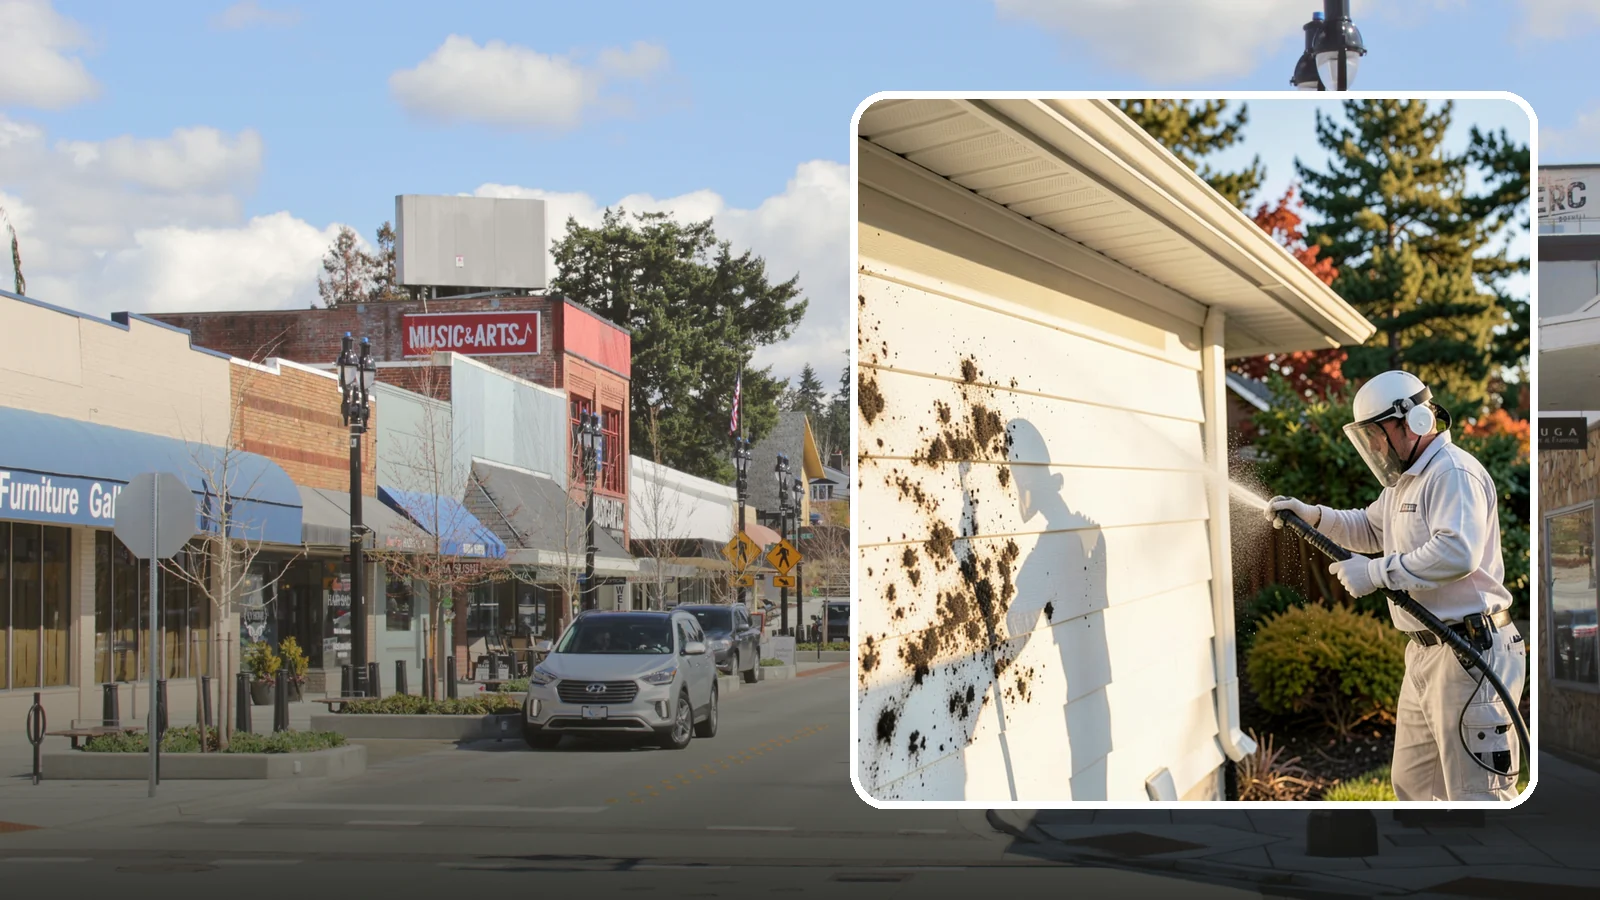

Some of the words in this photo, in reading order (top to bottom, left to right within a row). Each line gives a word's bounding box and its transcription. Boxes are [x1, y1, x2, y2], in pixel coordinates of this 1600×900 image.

[408, 322, 519, 349] MUSIC&ARTS
[0, 471, 79, 515] Furniture
[453, 563, 479, 574] SUSHI
